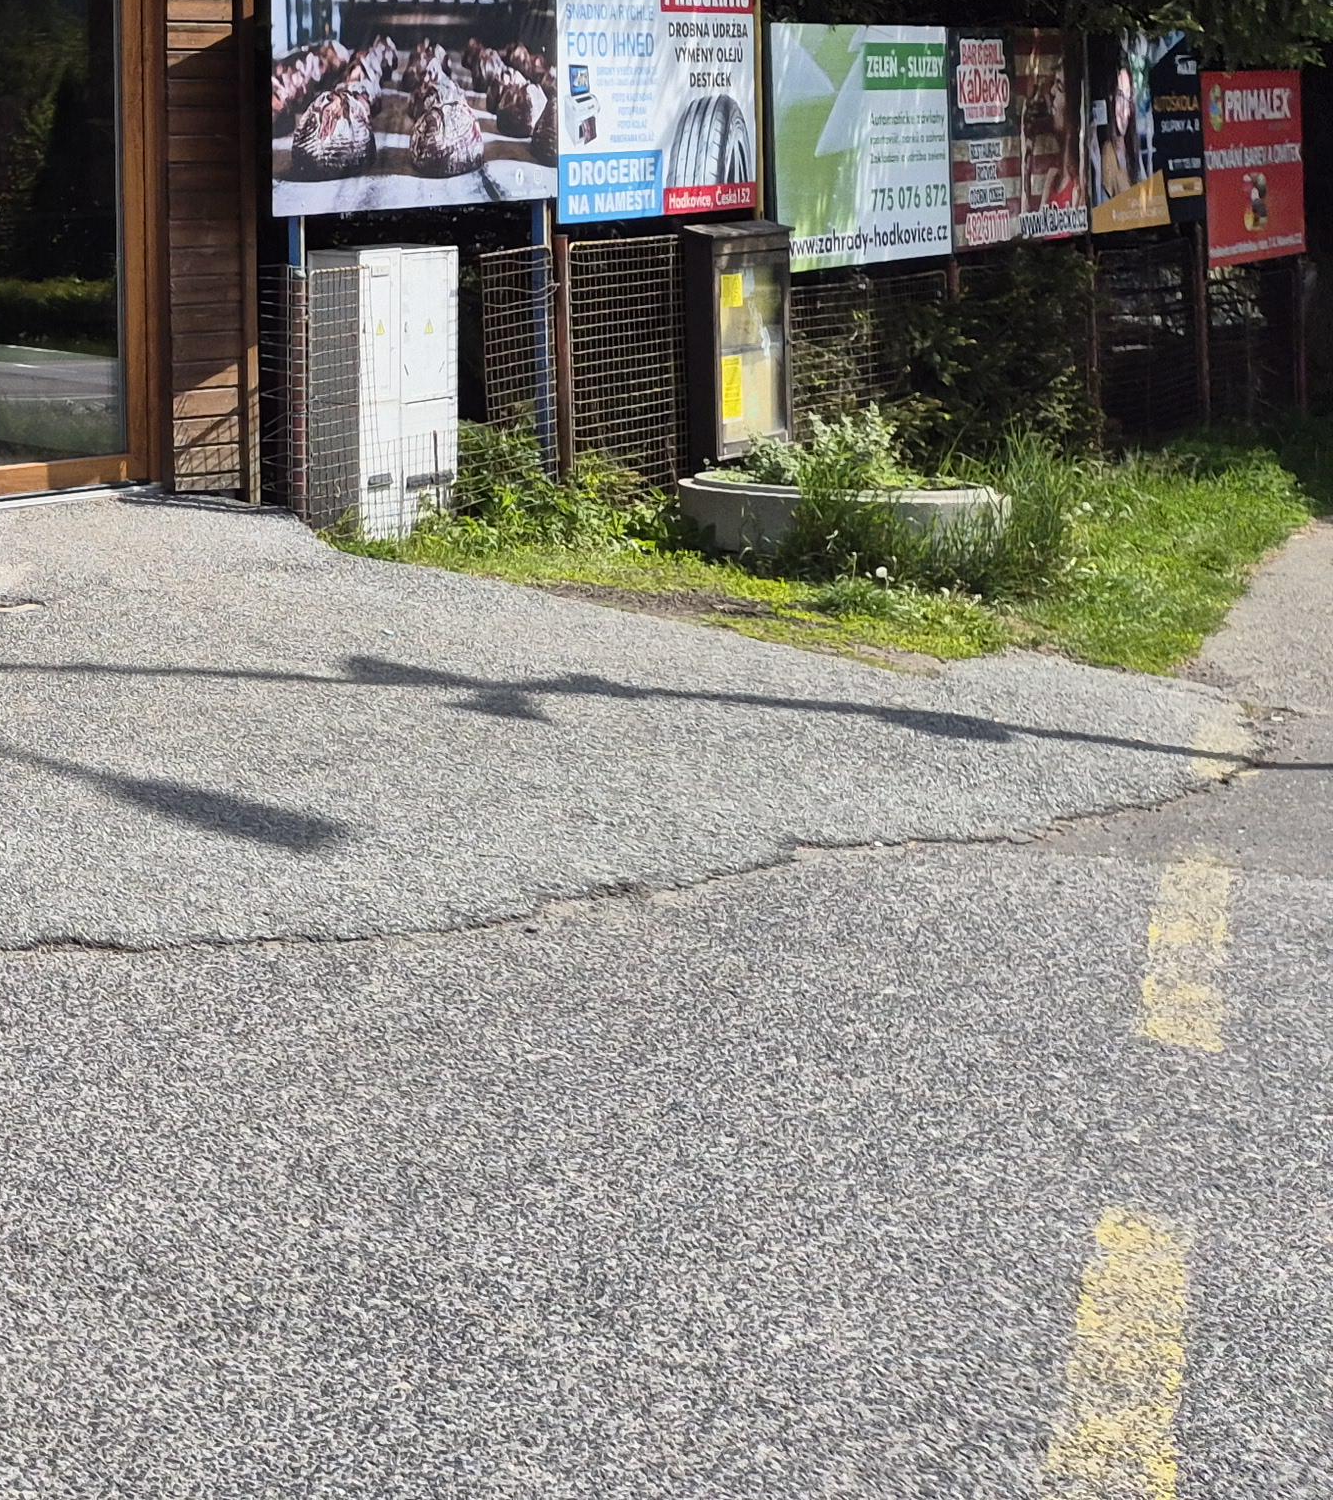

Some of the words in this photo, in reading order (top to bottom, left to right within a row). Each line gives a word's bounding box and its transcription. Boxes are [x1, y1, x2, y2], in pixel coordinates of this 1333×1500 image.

[668, 18, 709, 38] DROBNÁ
[566, 31, 608, 57] FOTO
[613, 31, 654, 58] IHNED
[866, 49, 898, 78] ZELEŇ
[908, 50, 944, 78] SLUŽBY
[1224, 88, 1292, 123] PRIMALEX
[568, 157, 655, 187] DROGERIE
[568, 195, 590, 215] NA
[669, 191, 713, 209] Hodkovice,
[871, 188, 894, 212] 775
[898, 186, 920, 209] 076
[925, 184, 947, 206] 872
